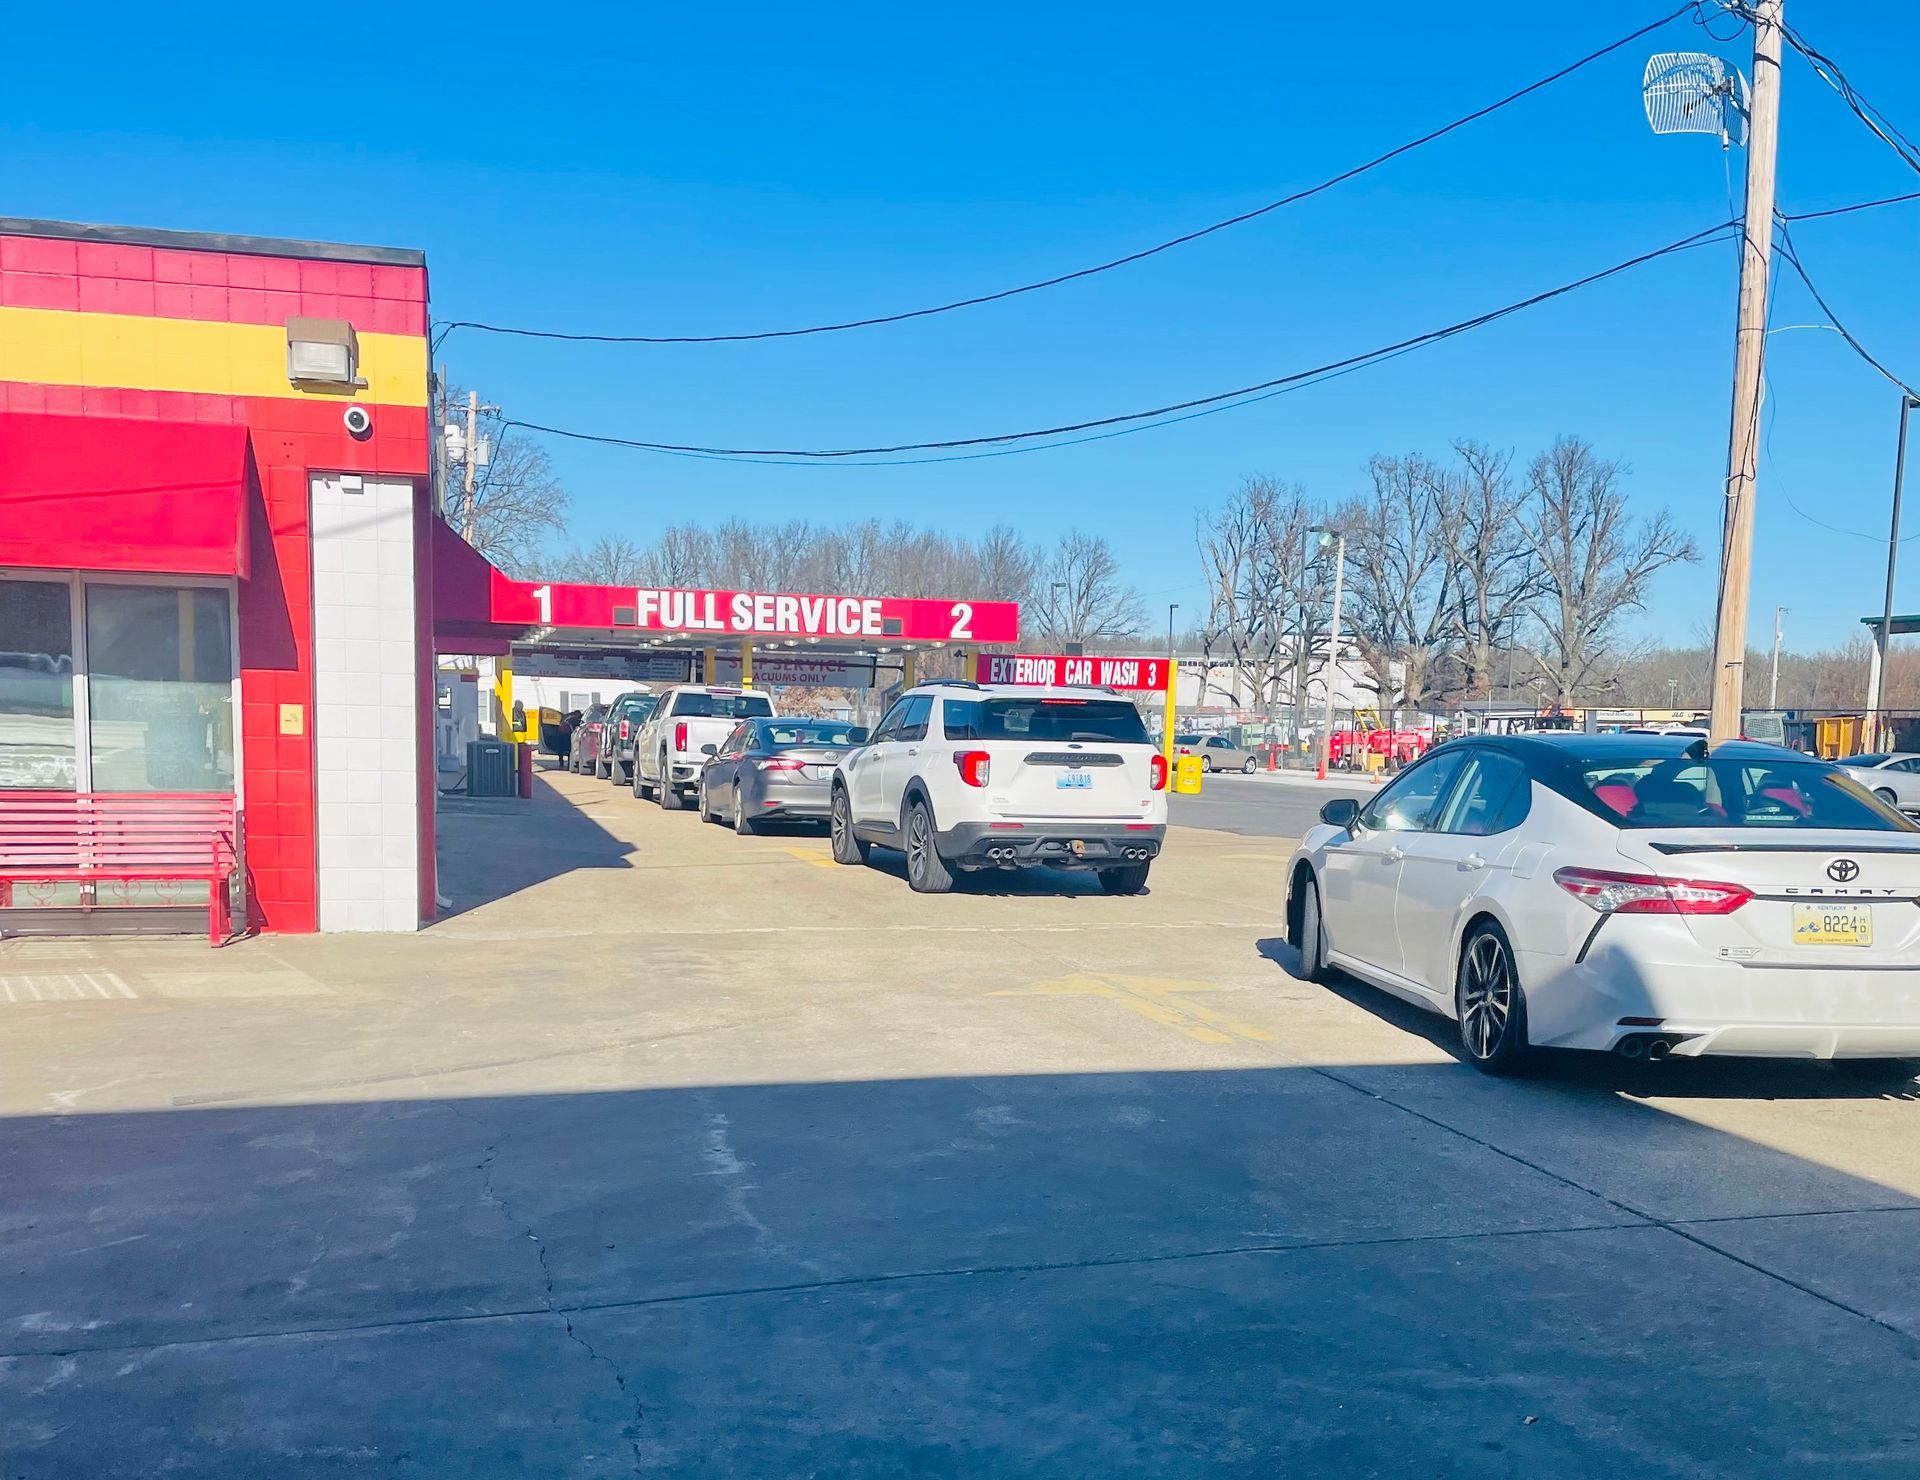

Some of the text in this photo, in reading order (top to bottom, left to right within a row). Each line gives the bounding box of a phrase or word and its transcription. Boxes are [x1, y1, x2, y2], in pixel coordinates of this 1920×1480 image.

[532, 585, 551, 623] 1
[637, 590, 883, 636] FULL SERVICE
[950, 603, 973, 639] 2
[751, 672, 827, 683] ACUUMS ONLY
[990, 657, 1157, 686] EXTERIOR CAR WASH 3
[1785, 887, 1896, 895] CAMRY
[1823, 915, 1858, 933] 8224
